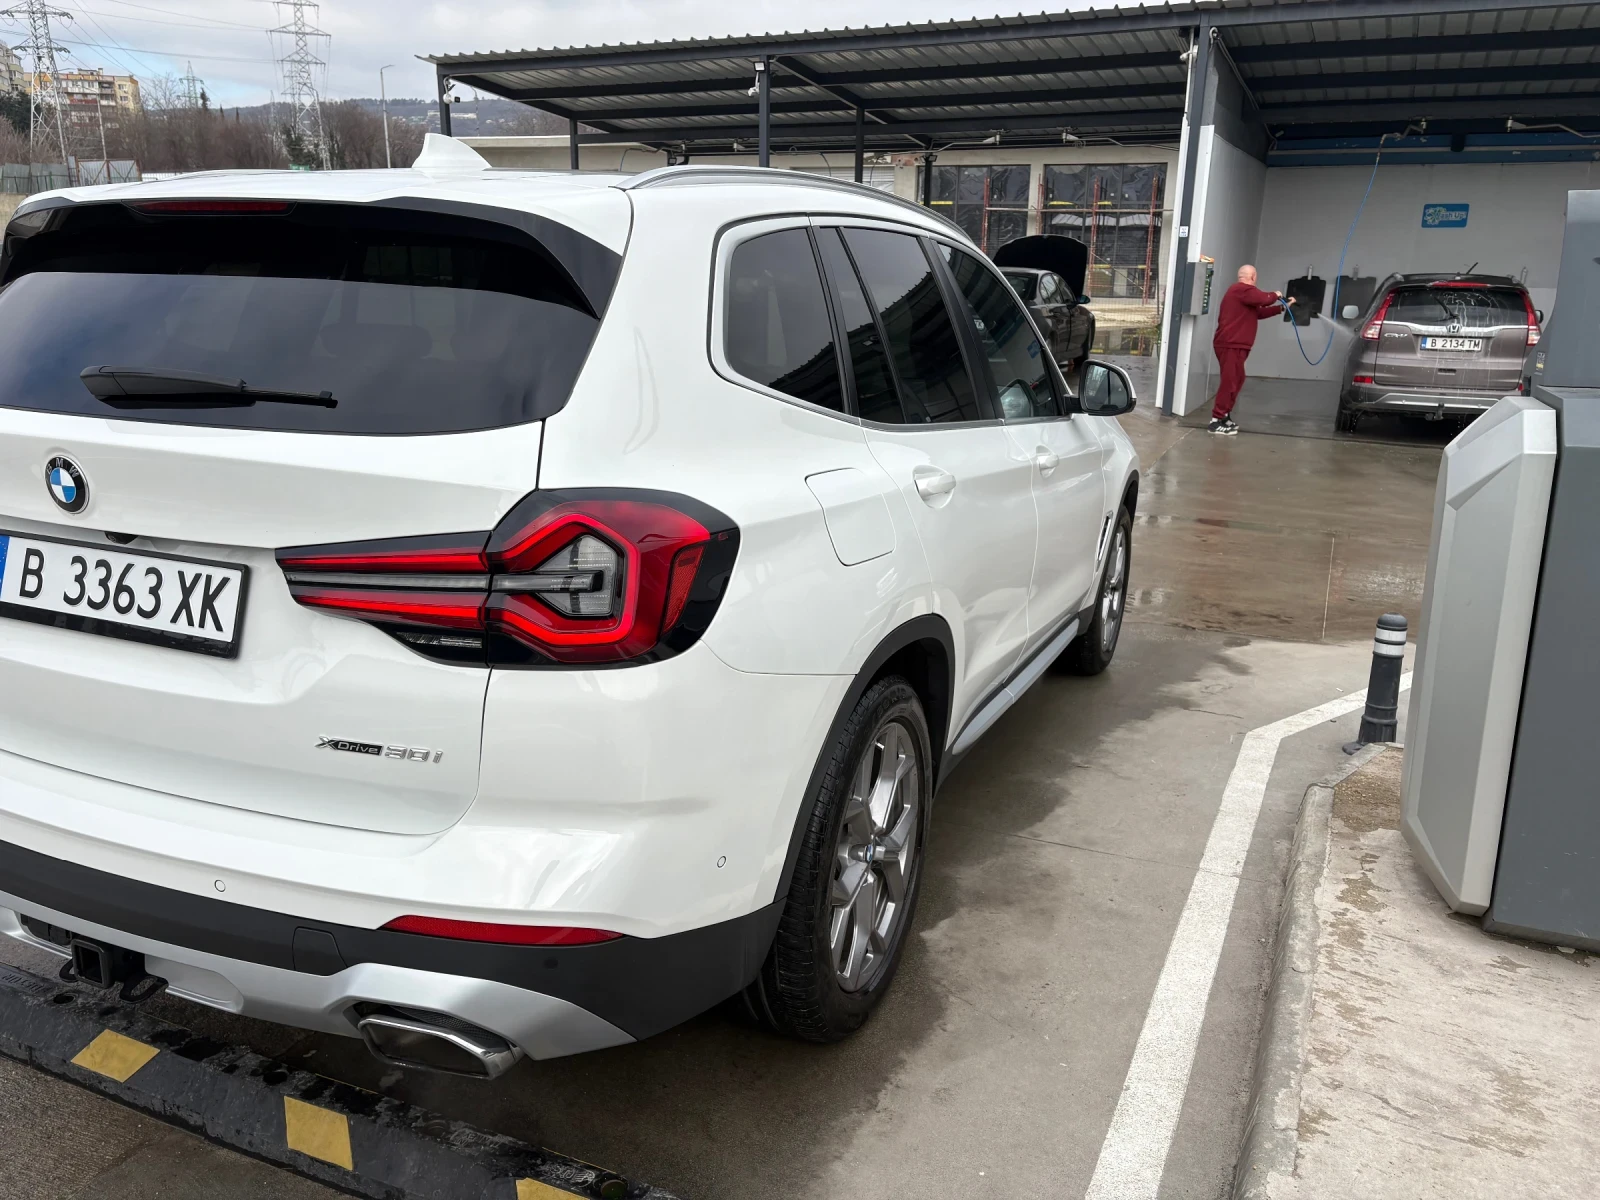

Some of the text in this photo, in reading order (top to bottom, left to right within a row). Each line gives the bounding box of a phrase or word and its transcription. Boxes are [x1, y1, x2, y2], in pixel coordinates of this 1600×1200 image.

[1431, 339, 1480, 349] B 2134 TM
[46, 457, 80, 478] BMW
[19, 547, 231, 632] B 3363 XK
